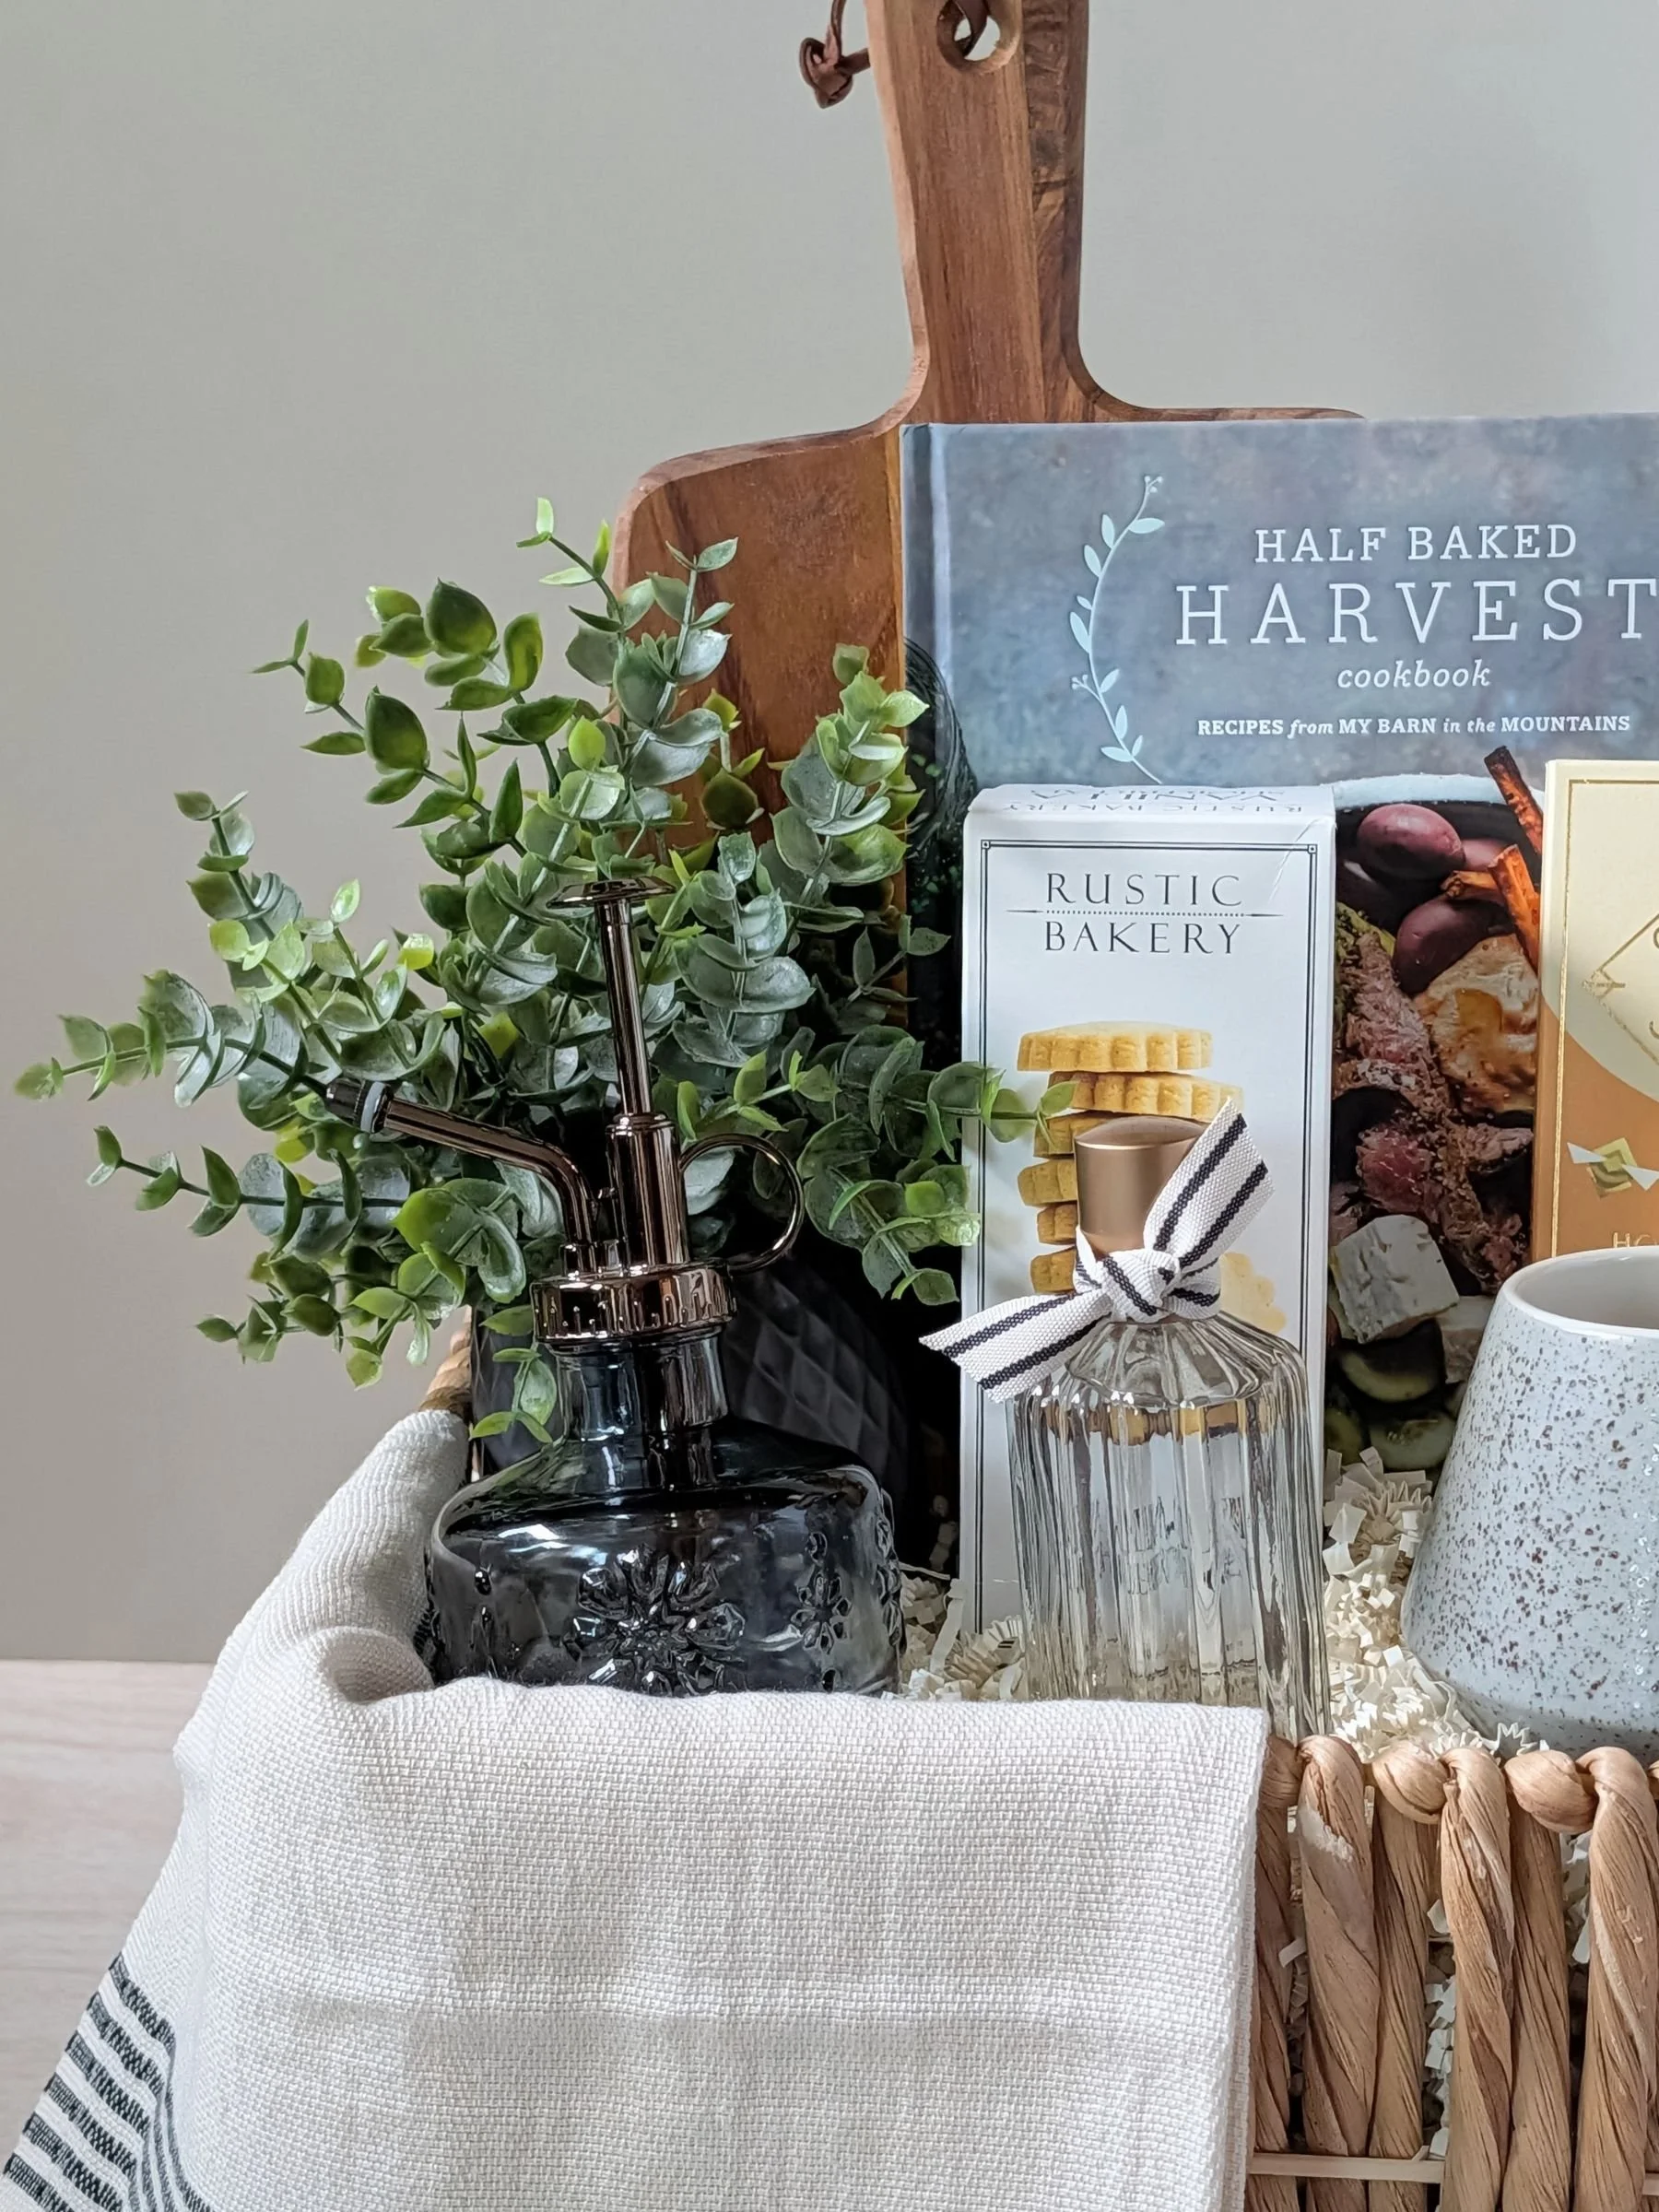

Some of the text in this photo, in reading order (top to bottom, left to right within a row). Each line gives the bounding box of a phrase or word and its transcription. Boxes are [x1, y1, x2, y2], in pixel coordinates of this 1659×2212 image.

[1254, 524, 1577, 563] HALF BAKED
[1176, 578, 1657, 646] HARVEST
[1337, 659, 1490, 688] cookbook
[1198, 715, 1630, 739] RECIPES from MY BARN in the MOUNTAINS
[1047, 873, 1241, 907] RUSTIC
[1045, 921, 1240, 954] BAKERY
